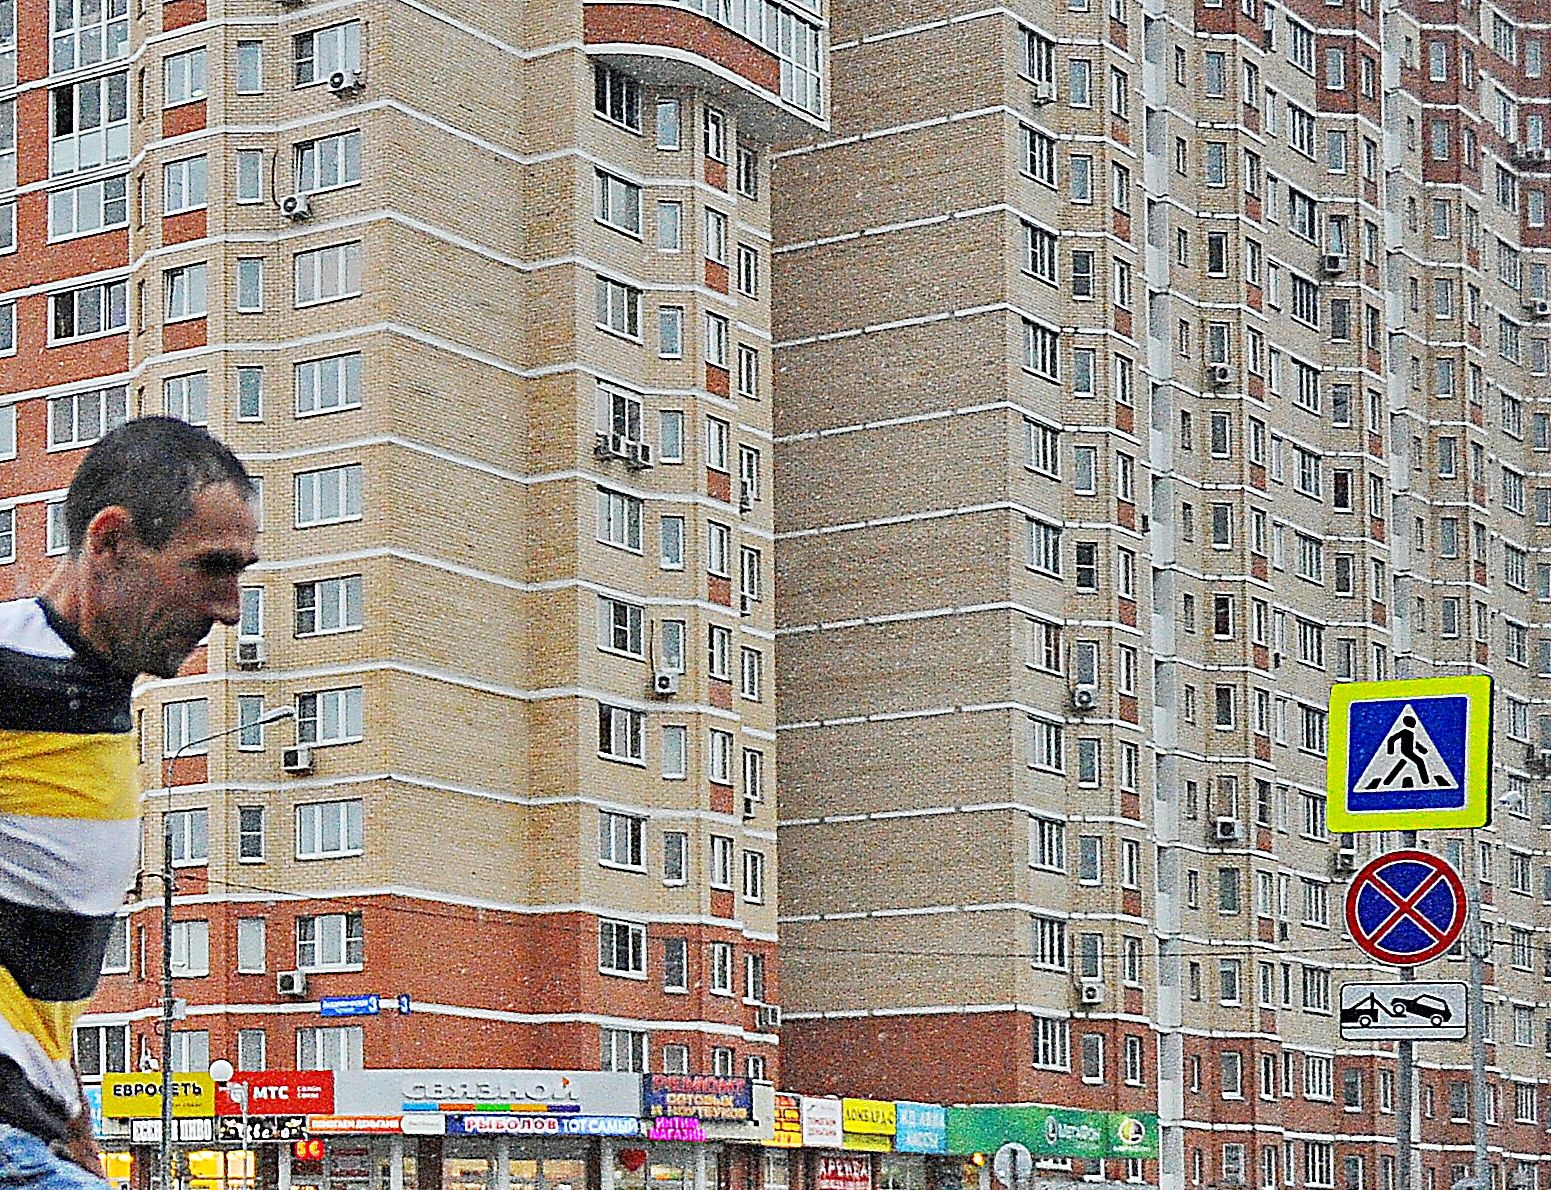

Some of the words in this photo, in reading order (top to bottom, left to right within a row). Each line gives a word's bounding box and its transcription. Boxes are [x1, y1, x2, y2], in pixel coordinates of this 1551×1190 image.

[368, 996, 377, 1013] 3
[114, 1083, 202, 1097] ЕВРОЕТЬ
[253, 1085, 289, 1100] МТС
[402, 1078, 579, 1100] СВЯЗНОЙ
[651, 1075, 745, 1094] РЕМОНТ
[464, 1117, 558, 1134] РЫБОЛОВ
[656, 1117, 700, 1128] ИНТИМ
[649, 1128, 706, 1140] МАГАЗИН
